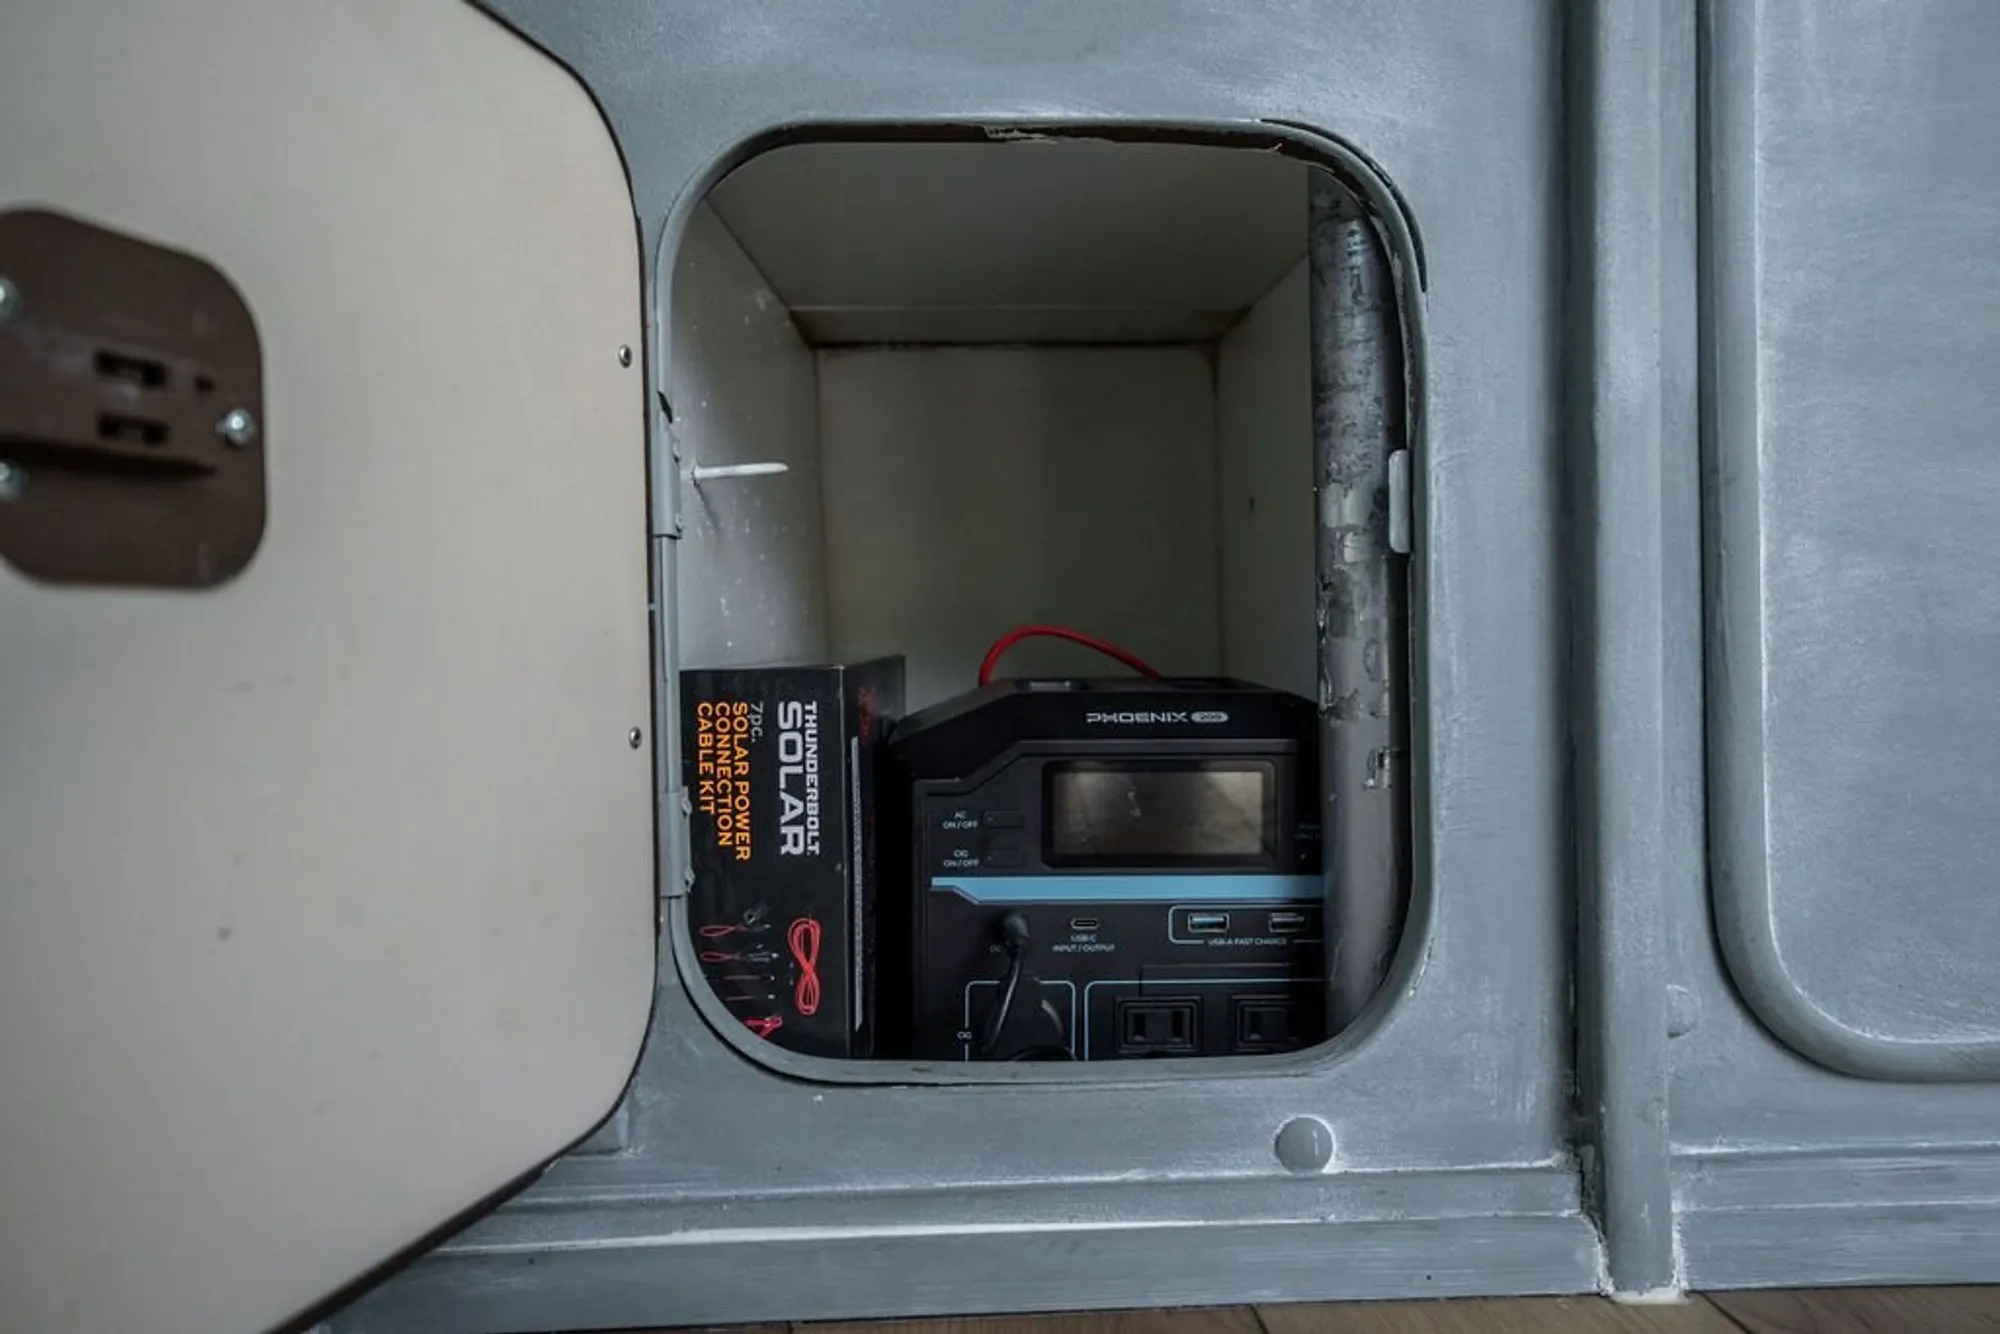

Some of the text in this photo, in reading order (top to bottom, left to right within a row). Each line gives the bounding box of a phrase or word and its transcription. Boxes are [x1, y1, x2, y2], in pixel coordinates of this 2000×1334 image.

[697, 702, 716, 816] CABLE KIT
[715, 702, 733, 846] CONNECTION
[733, 702, 751, 861] SOLAR POWER
[749, 701, 764, 743] 7pc.
[778, 701, 805, 856] SOLAR
[804, 701, 820, 856] THUNDERBOLT
